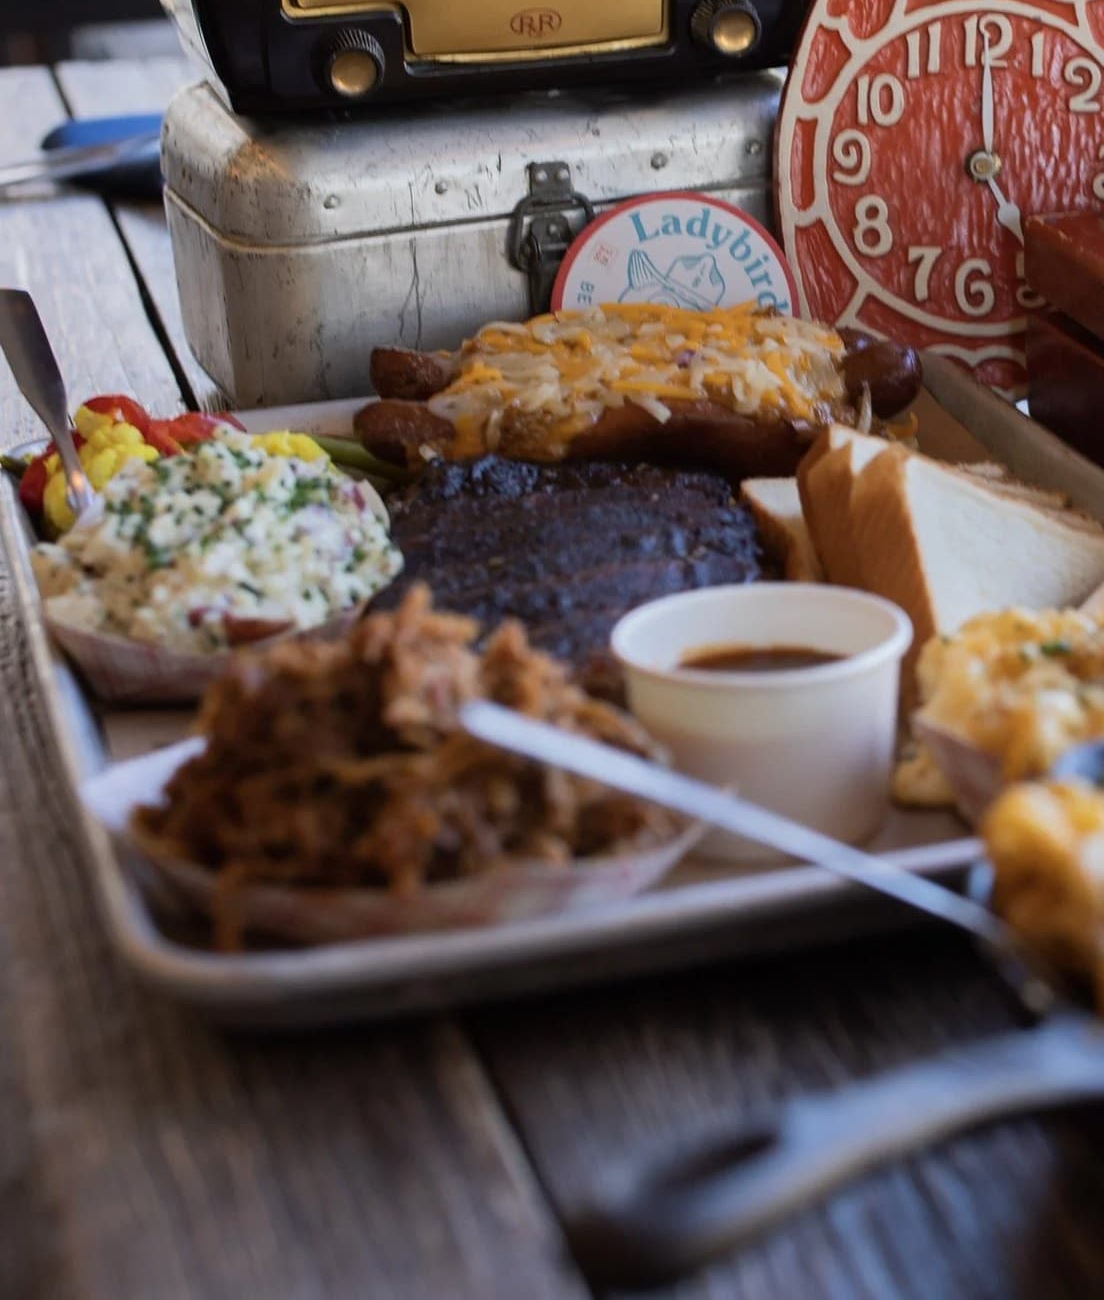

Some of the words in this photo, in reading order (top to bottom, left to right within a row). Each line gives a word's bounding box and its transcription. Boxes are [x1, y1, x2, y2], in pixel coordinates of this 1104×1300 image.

[907, 21, 942, 80] 11
[964, 13, 1013, 68] 12
[1031, 31, 1045, 78] 1
[856, 73, 905, 127] 10
[1064, 56, 1102, 114] 2
[832, 128, 872, 186] 9
[854, 195, 893, 258] 8
[629, 207, 789, 313] Ladybird
[907, 245, 942, 301] 7
[954, 258, 996, 318] 6
